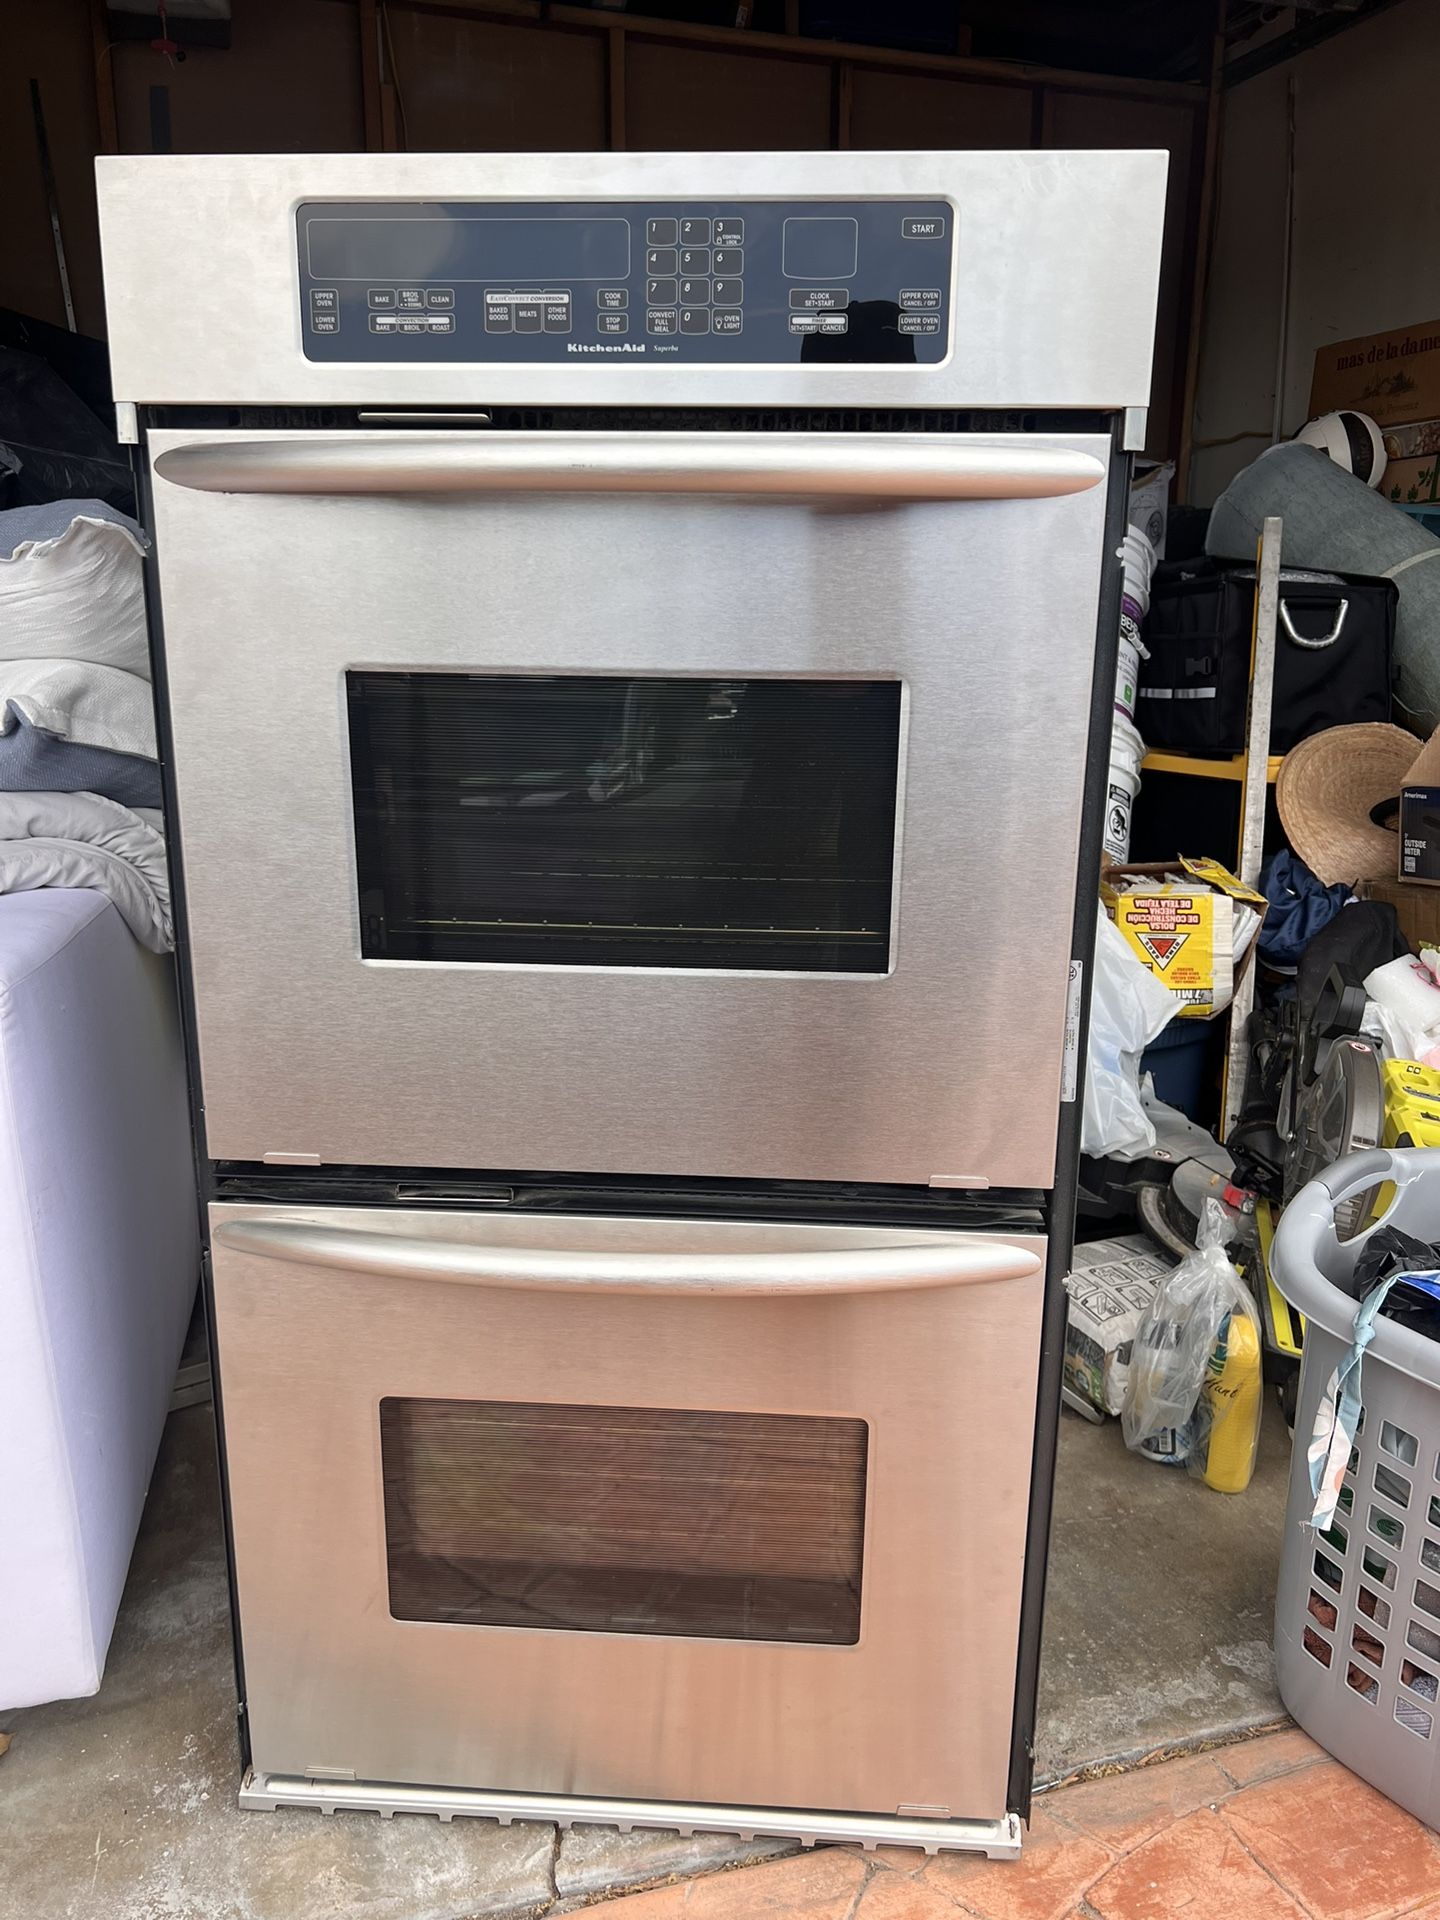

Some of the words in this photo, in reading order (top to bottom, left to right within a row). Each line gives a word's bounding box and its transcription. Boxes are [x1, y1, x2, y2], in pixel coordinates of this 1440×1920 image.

[684, 222, 692, 232] 2
[717, 222, 724, 232] 3
[911, 224, 935, 234] START
[650, 253, 657, 262] 4
[684, 252, 691, 262] 5
[717, 252, 724, 262] 6
[651, 282, 657, 292] 7
[684, 282, 691, 292] 8
[717, 282, 724, 292] 9
[604, 292, 621, 300] COOK
[684, 312, 691, 321] 0
[567, 343, 646, 352] KitchenAid
[653, 344, 679, 353] Superba
[1336, 352, 1365, 371] mas
[1367, 345, 1385, 364] de
[1386, 342, 1398, 360] la
[1404, 839, 1427, 849] OUTSIDE
[1135, 899, 1159, 908] TEJIDA
[1160, 900, 1178, 908] TELA
[1182, 900, 1191, 908] DE
[1128, 914, 1186, 923] CONSTRUCCIÓN
[1187, 915, 1199, 923] DE
[1194, 990, 1202, 998] 7
